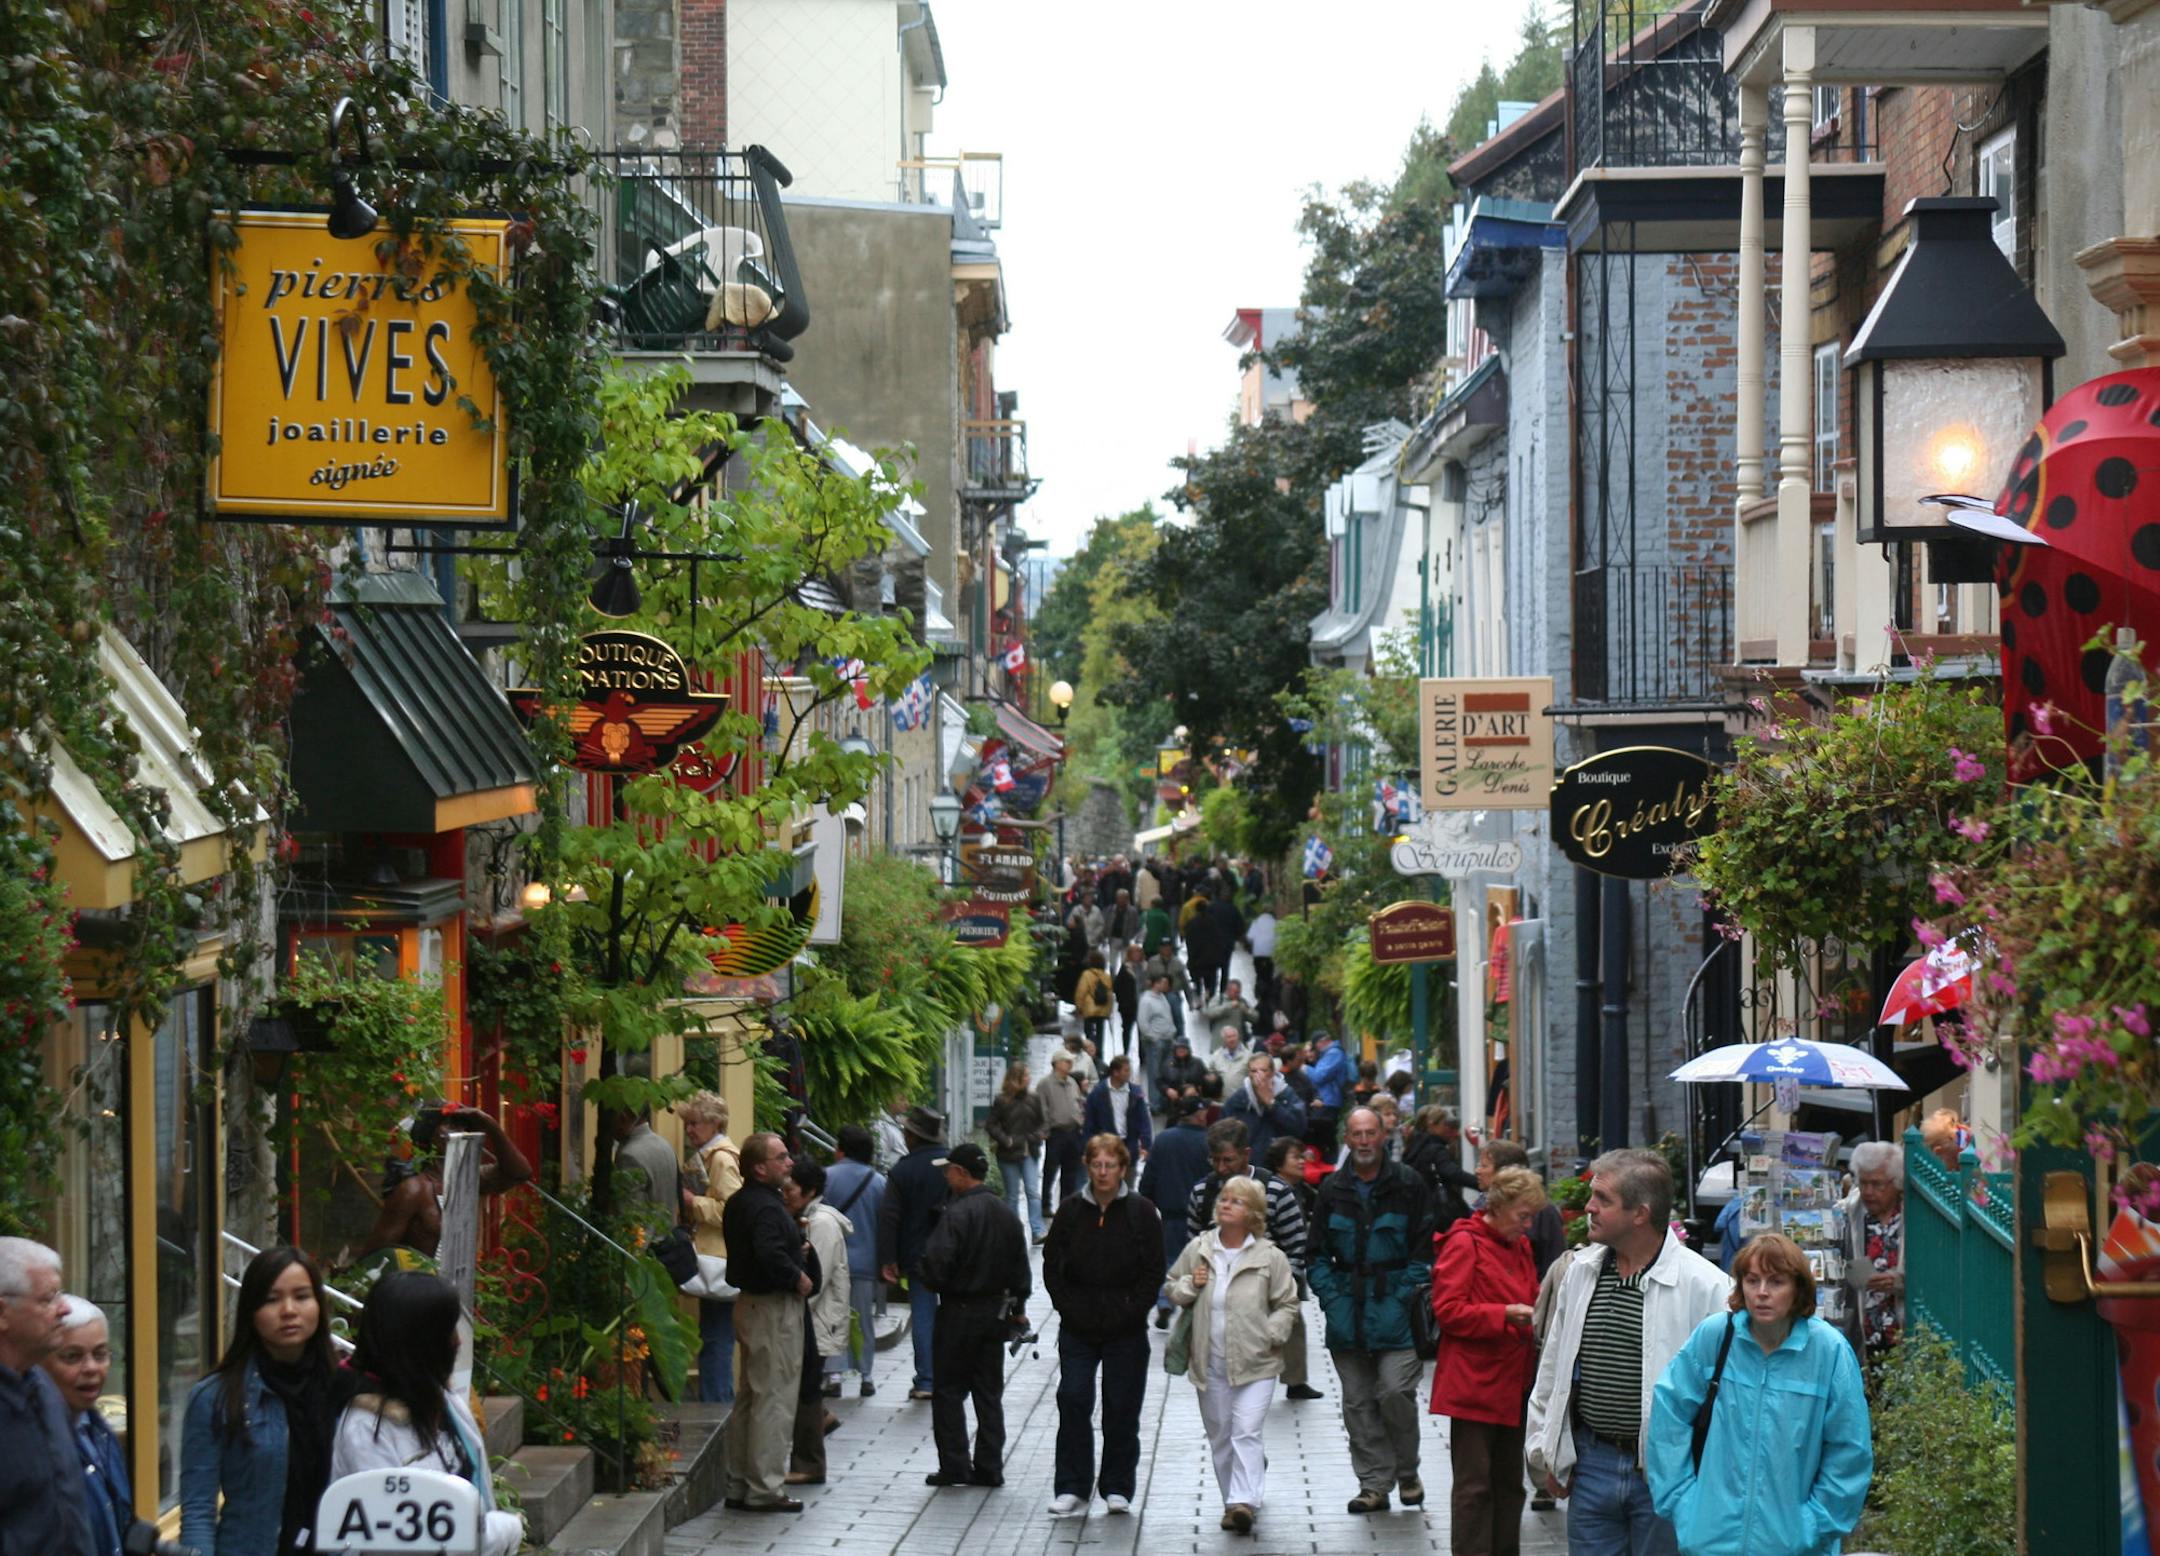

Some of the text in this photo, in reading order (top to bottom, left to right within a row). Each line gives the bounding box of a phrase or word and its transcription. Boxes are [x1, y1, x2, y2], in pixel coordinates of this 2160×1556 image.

[263, 257, 450, 309] pierres
[270, 315, 451, 406] VIVES
[267, 416, 449, 446] joaillerie
[309, 452, 400, 490] signée
[563, 643, 675, 673] OUTIQUE
[1462, 714, 1530, 736] D'ART
[1434, 693, 1458, 796] GALERIE
[1483, 771, 1530, 794] Denis
[1578, 772, 1631, 785] Boutique
[1396, 843, 1517, 875] Scrupules
[384, 1476, 411, 1493] 55
[336, 1498, 456, 1542] A-36
